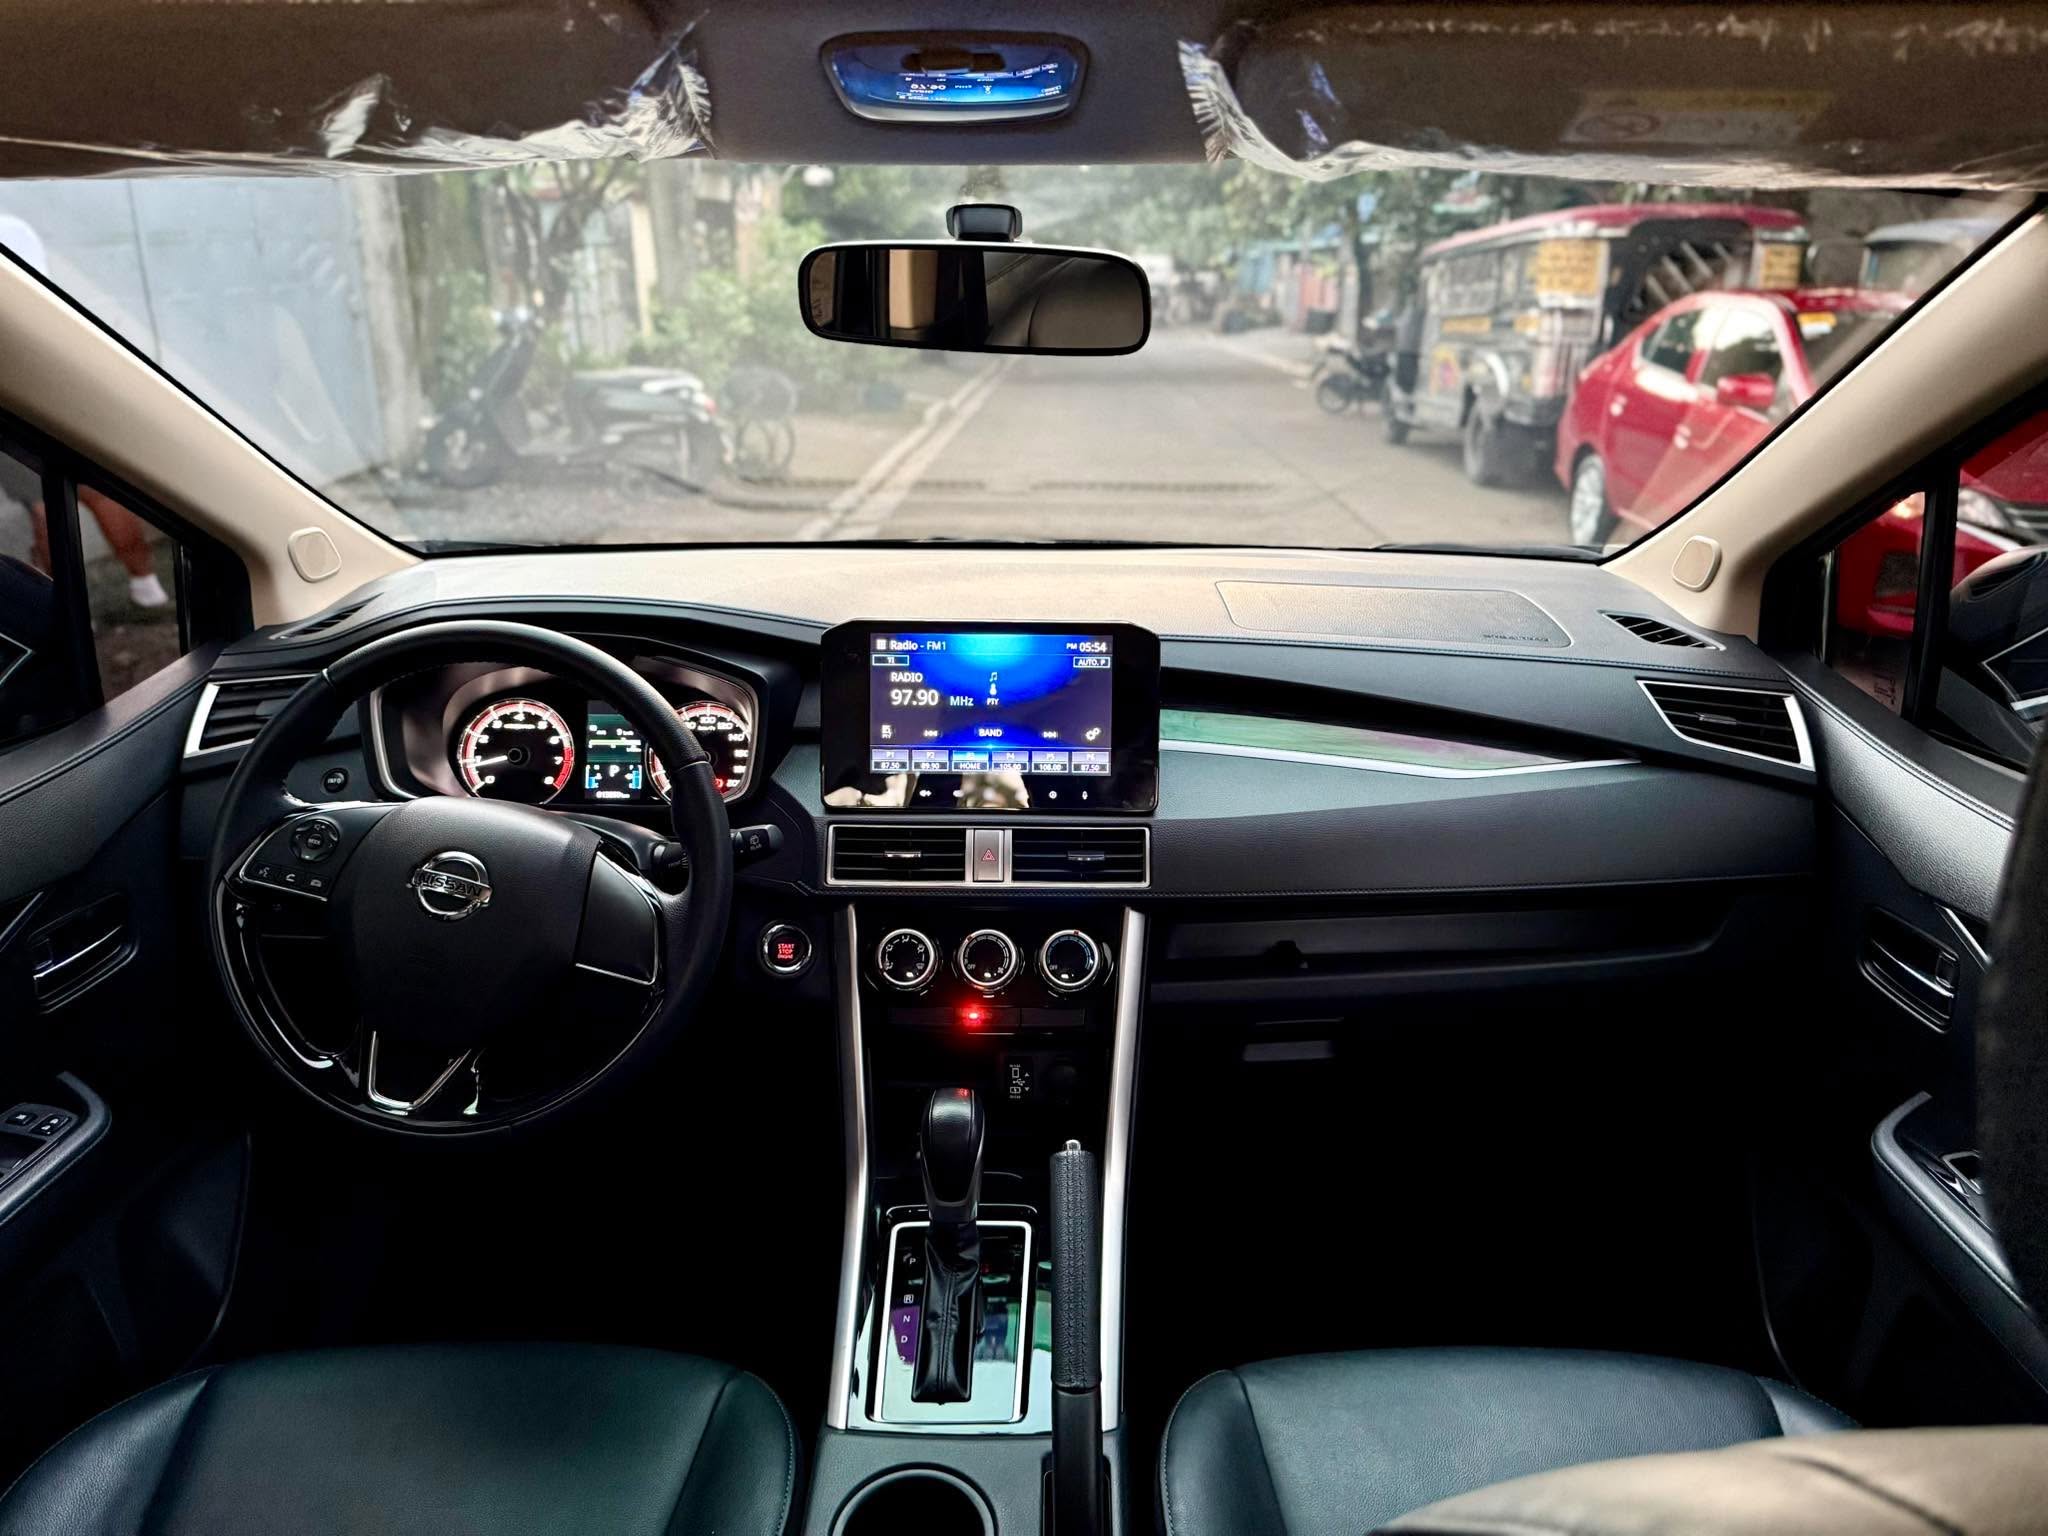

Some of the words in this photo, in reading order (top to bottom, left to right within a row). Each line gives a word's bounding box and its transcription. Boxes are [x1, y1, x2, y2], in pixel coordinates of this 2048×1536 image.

[890, 640, 918, 650] Radio
[927, 641, 946, 650] FM1
[1079, 642, 1107, 652] 05:54
[891, 672, 923, 682] RADIO
[891, 689, 939, 706] 97.90
[950, 696, 974, 706] MHz
[979, 729, 1002, 738] BAND
[960, 762, 980, 770] HOME
[909, 1257, 916, 1265] P
[901, 1335, 908, 1343] D
